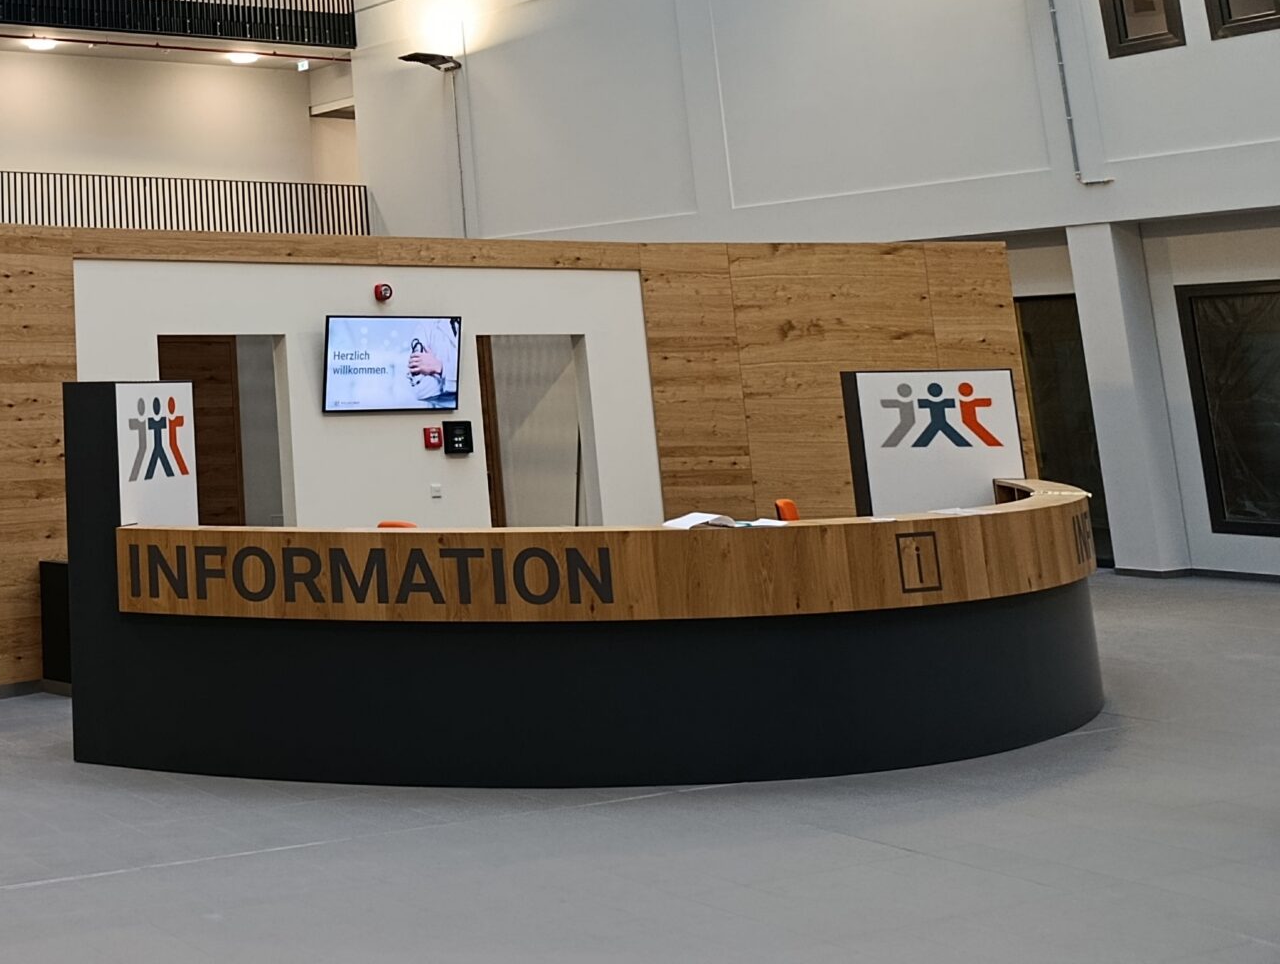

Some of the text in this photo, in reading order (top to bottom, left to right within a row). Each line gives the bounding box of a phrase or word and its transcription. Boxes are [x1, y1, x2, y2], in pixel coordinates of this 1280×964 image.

[333, 350, 370, 361] Herzlich
[332, 365, 388, 375] willkommen.
[128, 544, 615, 604] INFORMATION
